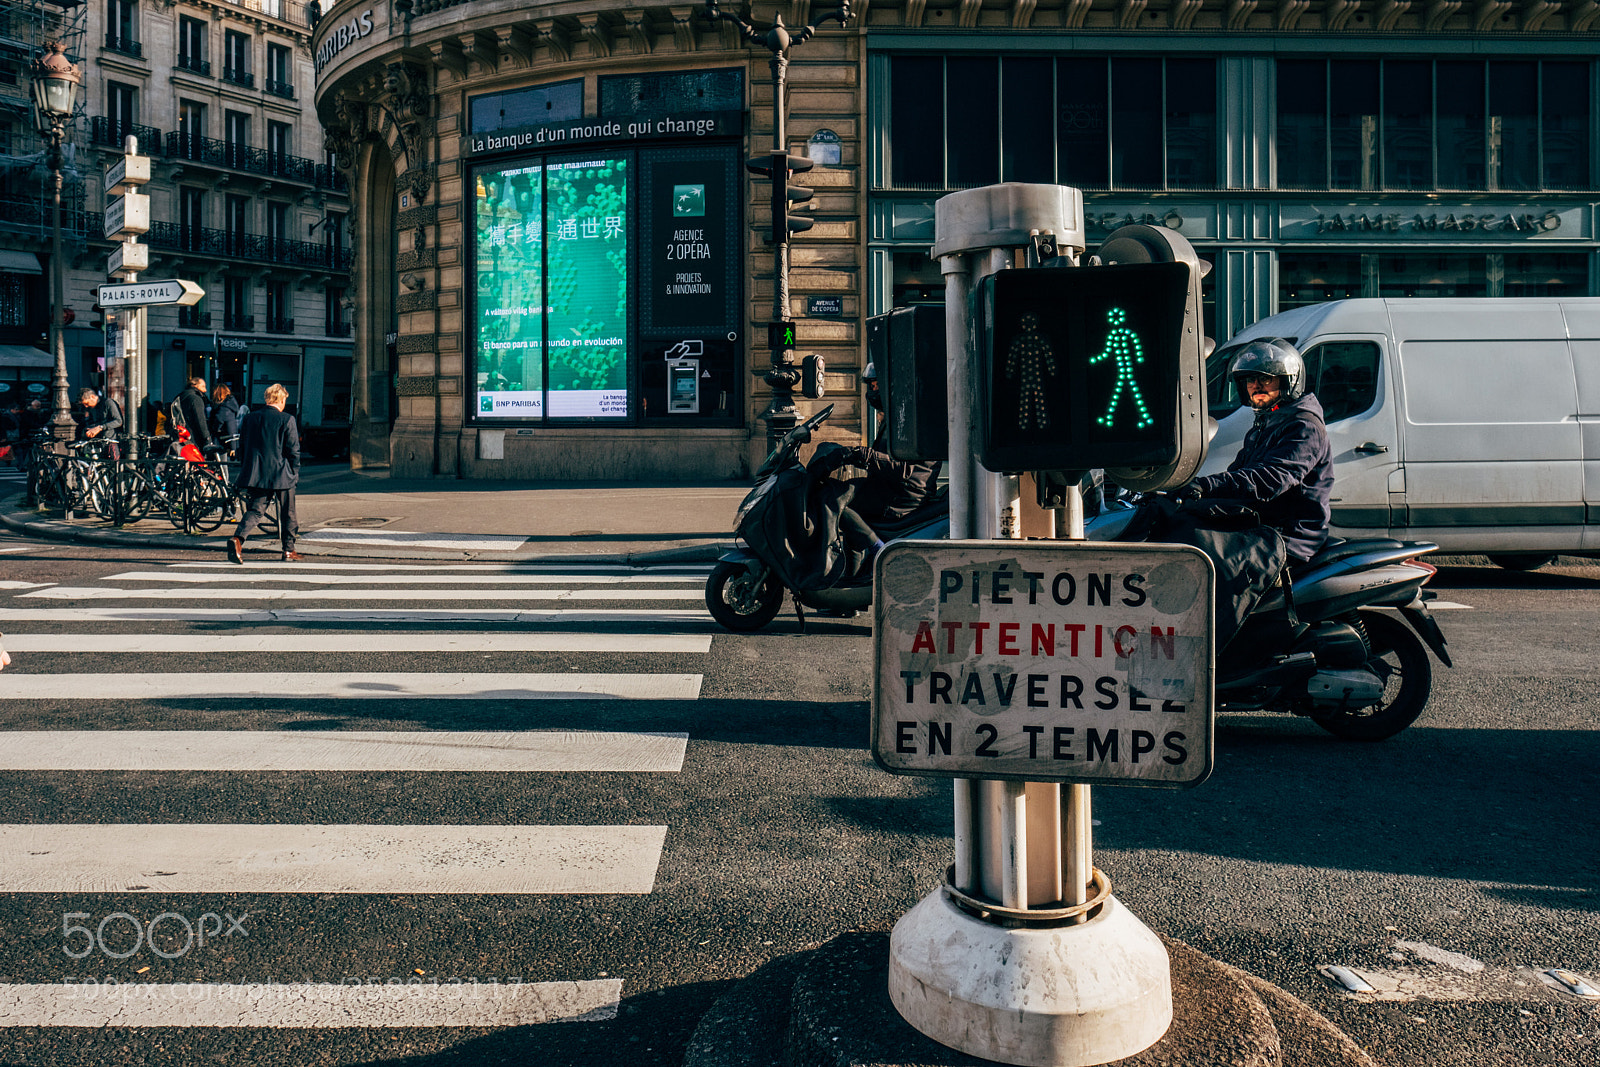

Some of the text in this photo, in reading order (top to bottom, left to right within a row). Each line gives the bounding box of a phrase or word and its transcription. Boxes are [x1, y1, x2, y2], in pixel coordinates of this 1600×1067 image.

[316, 9, 373, 74] PARIBAS
[471, 118, 715, 152] La banque d'un monde qui change
[1316, 213, 1401, 233] JAIME
[673, 229, 704, 241] AGENCE
[667, 240, 711, 260] 2 OPÉRA
[676, 272, 702, 283] PROJETS
[102, 288, 171, 300] PALAIS-ROYAL
[666, 283, 711, 295] & INNOVATION
[483, 341, 490, 349] El
[491, 341, 511, 349] banco
[512, 341, 528, 350] para
[529, 340, 538, 348] un
[584, 336, 623, 346] evolución
[939, 564, 1147, 608] PIÉTONS
[911, 620, 1175, 660] ATTENTION
[896, 721, 1188, 765] EN 2 TEMPS
